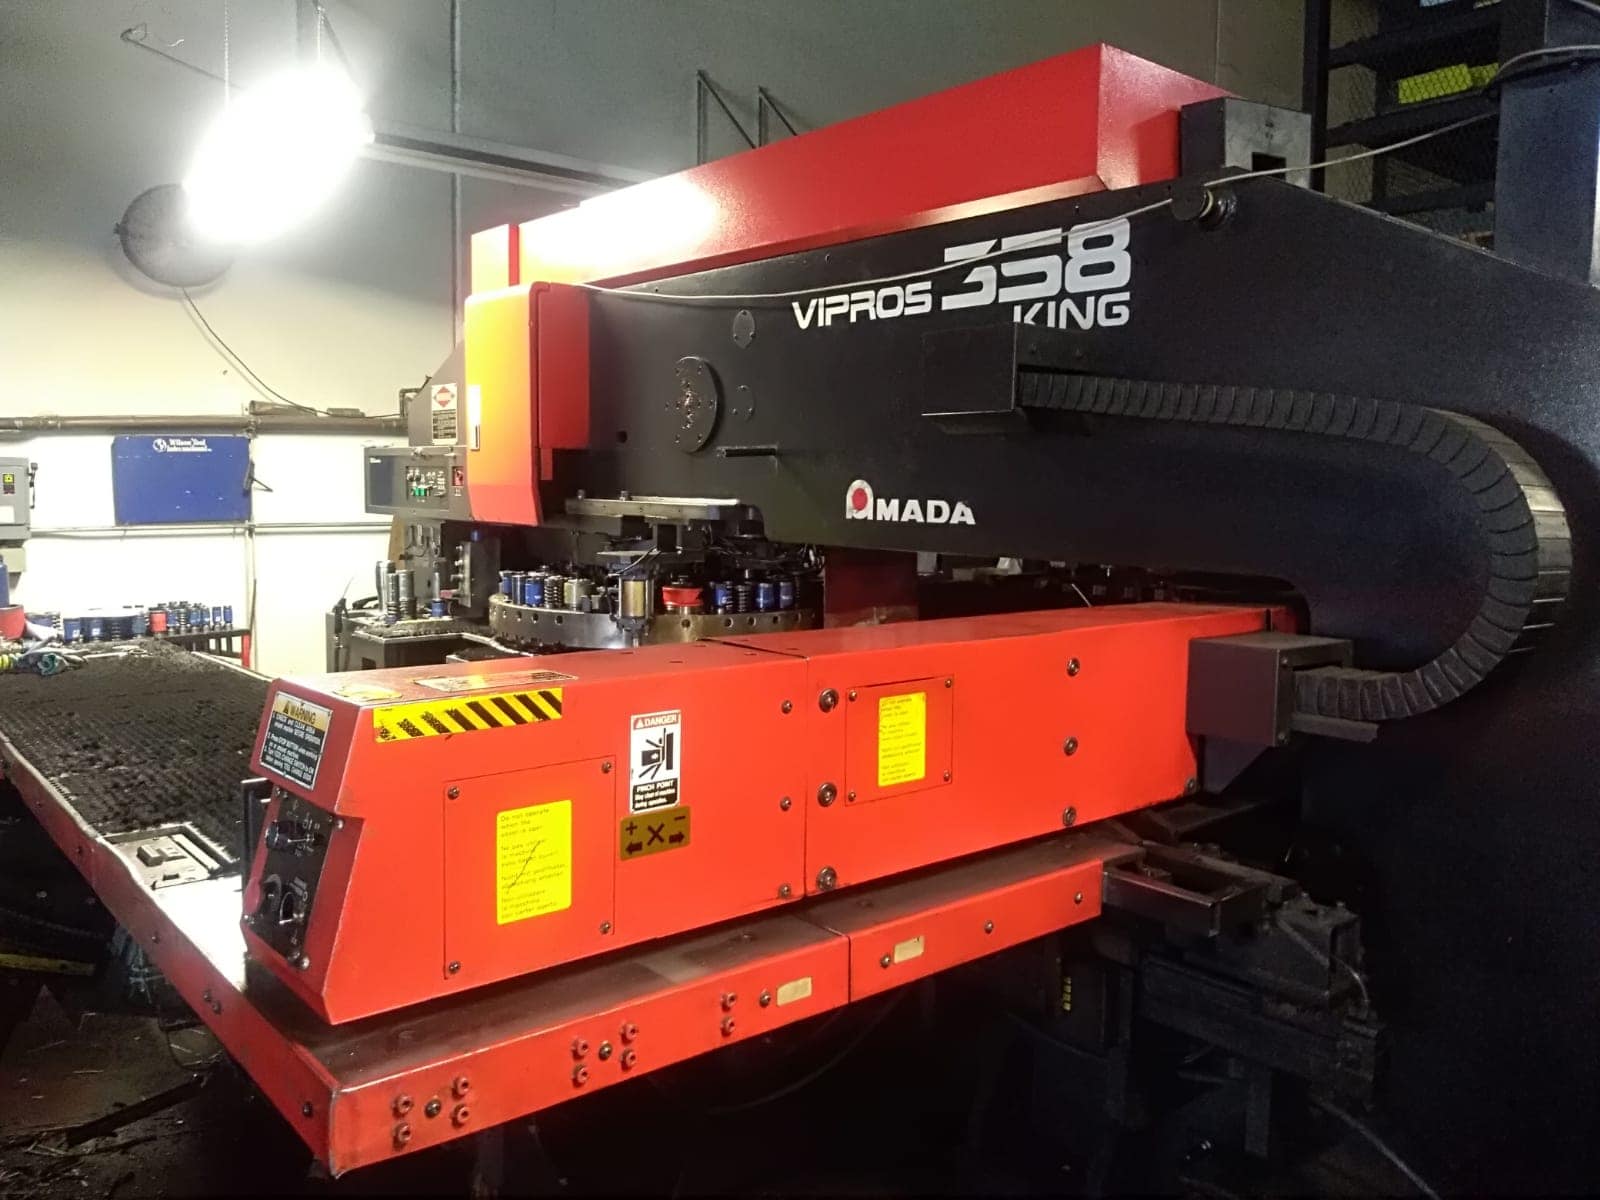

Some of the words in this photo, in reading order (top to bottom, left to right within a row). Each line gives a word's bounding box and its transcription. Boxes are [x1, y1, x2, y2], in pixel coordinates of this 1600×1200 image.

[791, 281, 932, 329] VIPROS
[941, 218, 1131, 311] 358
[1013, 292, 1131, 330] KING
[846, 479, 976, 525] AMADA
[289, 702, 316, 724] WARNING
[644, 714, 677, 728] DANGER
